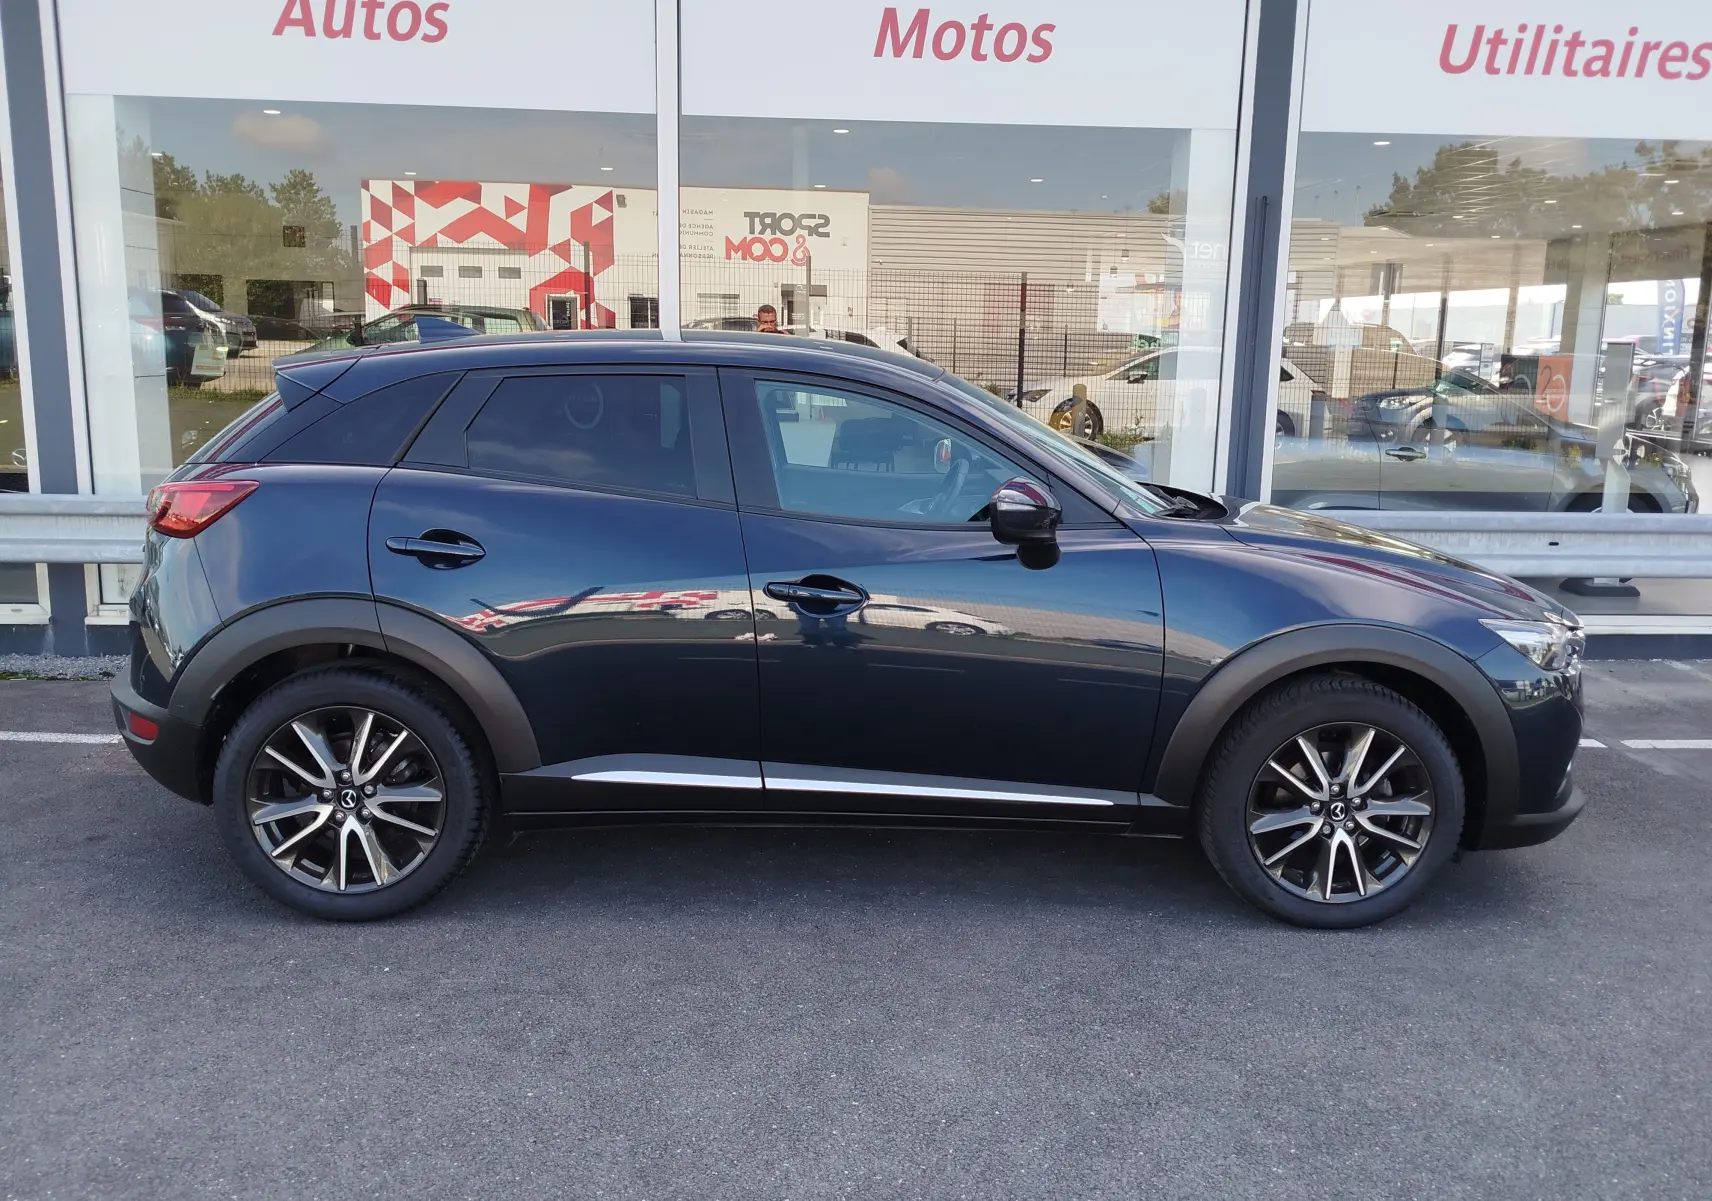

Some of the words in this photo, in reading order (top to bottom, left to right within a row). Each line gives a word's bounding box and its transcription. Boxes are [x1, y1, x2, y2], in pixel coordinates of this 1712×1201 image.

[272, 0, 450, 43] Autos
[873, 7, 1056, 63] Motos
[1439, 23, 1712, 80] Utilitaires
